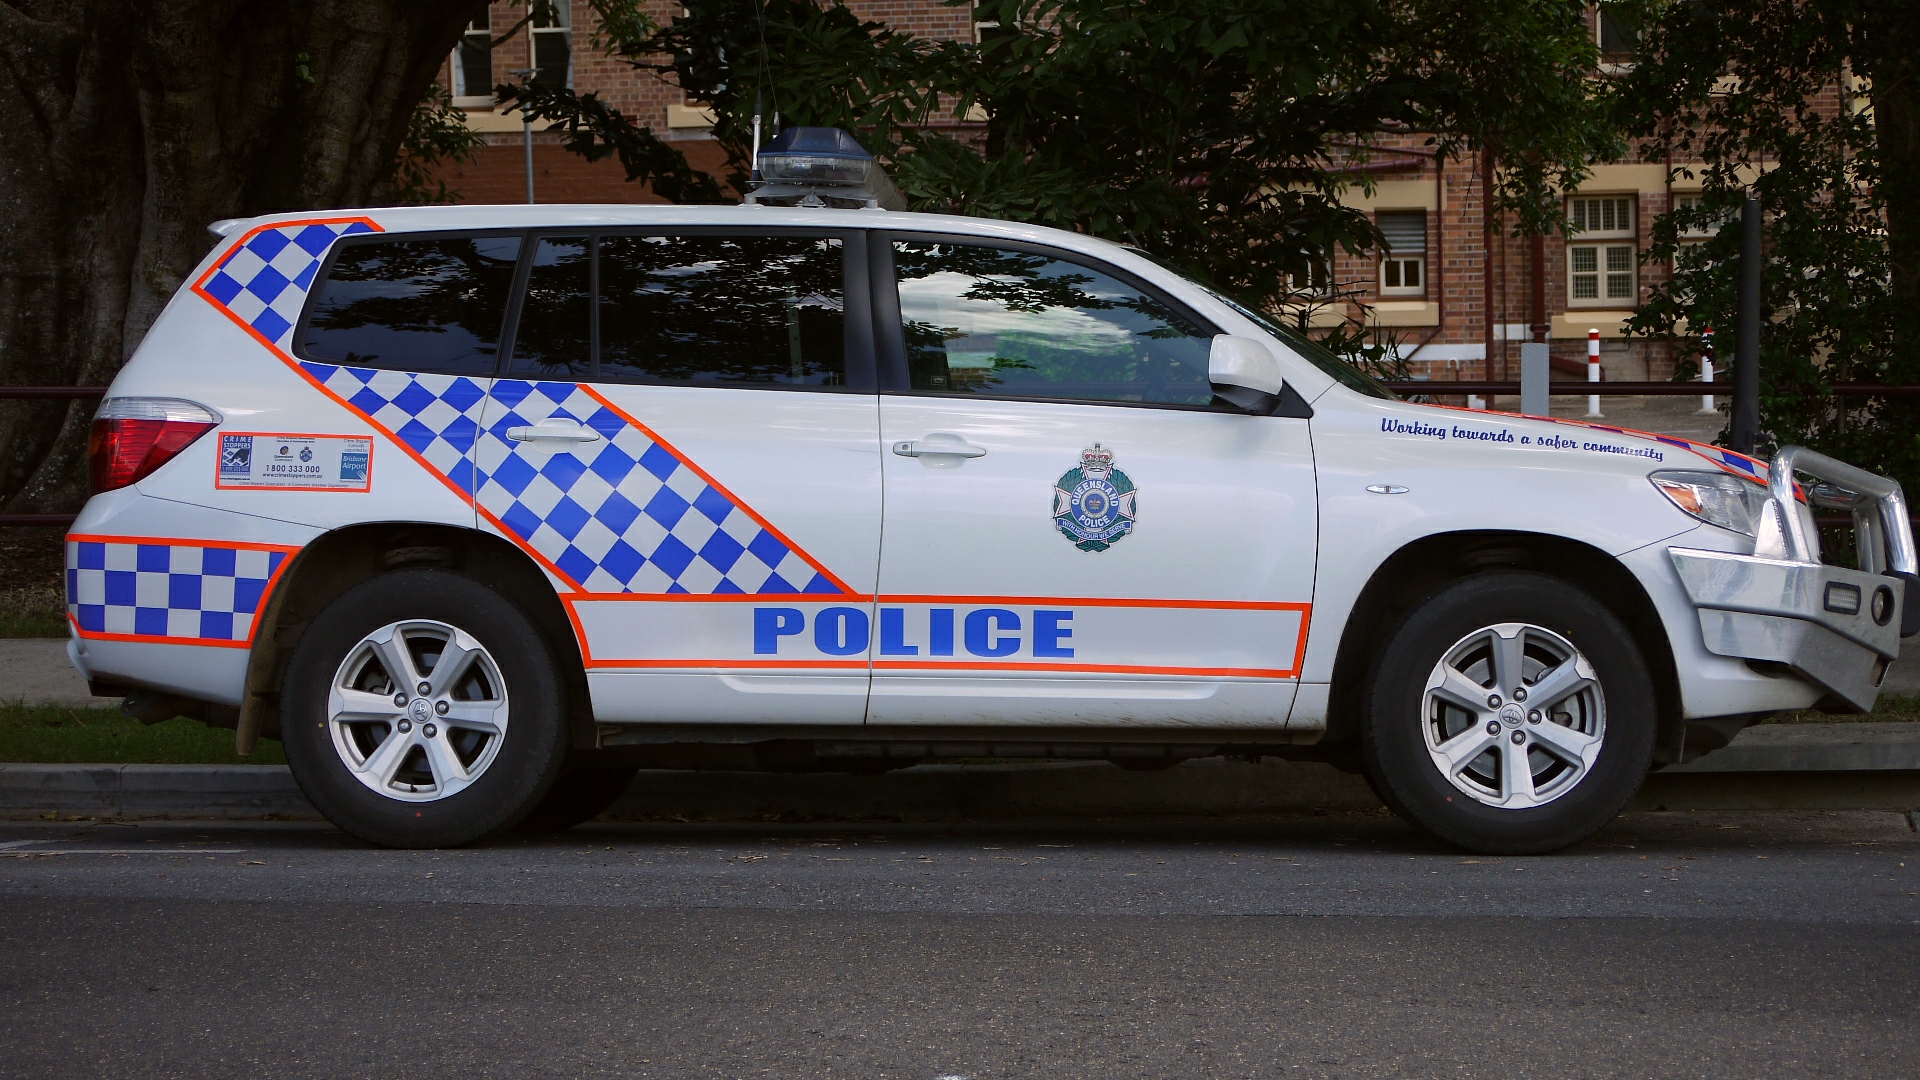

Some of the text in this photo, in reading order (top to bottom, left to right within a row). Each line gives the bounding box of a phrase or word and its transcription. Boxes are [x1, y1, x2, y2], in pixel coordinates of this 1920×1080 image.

[1381, 418, 1664, 462] Working towards a safer community
[271, 464, 286, 472] 800
[288, 465, 303, 473] 333
[305, 465, 320, 473] 000
[342, 462, 366, 470] Airport
[1071, 480, 1119, 507] QUEENSLAND
[1062, 520, 1075, 531] WITH
[1074, 526, 1099, 540] HONOUR
[1099, 531, 1109, 539] WE
[1078, 514, 1111, 528] POLICE
[753, 606, 1075, 658] POLICE
